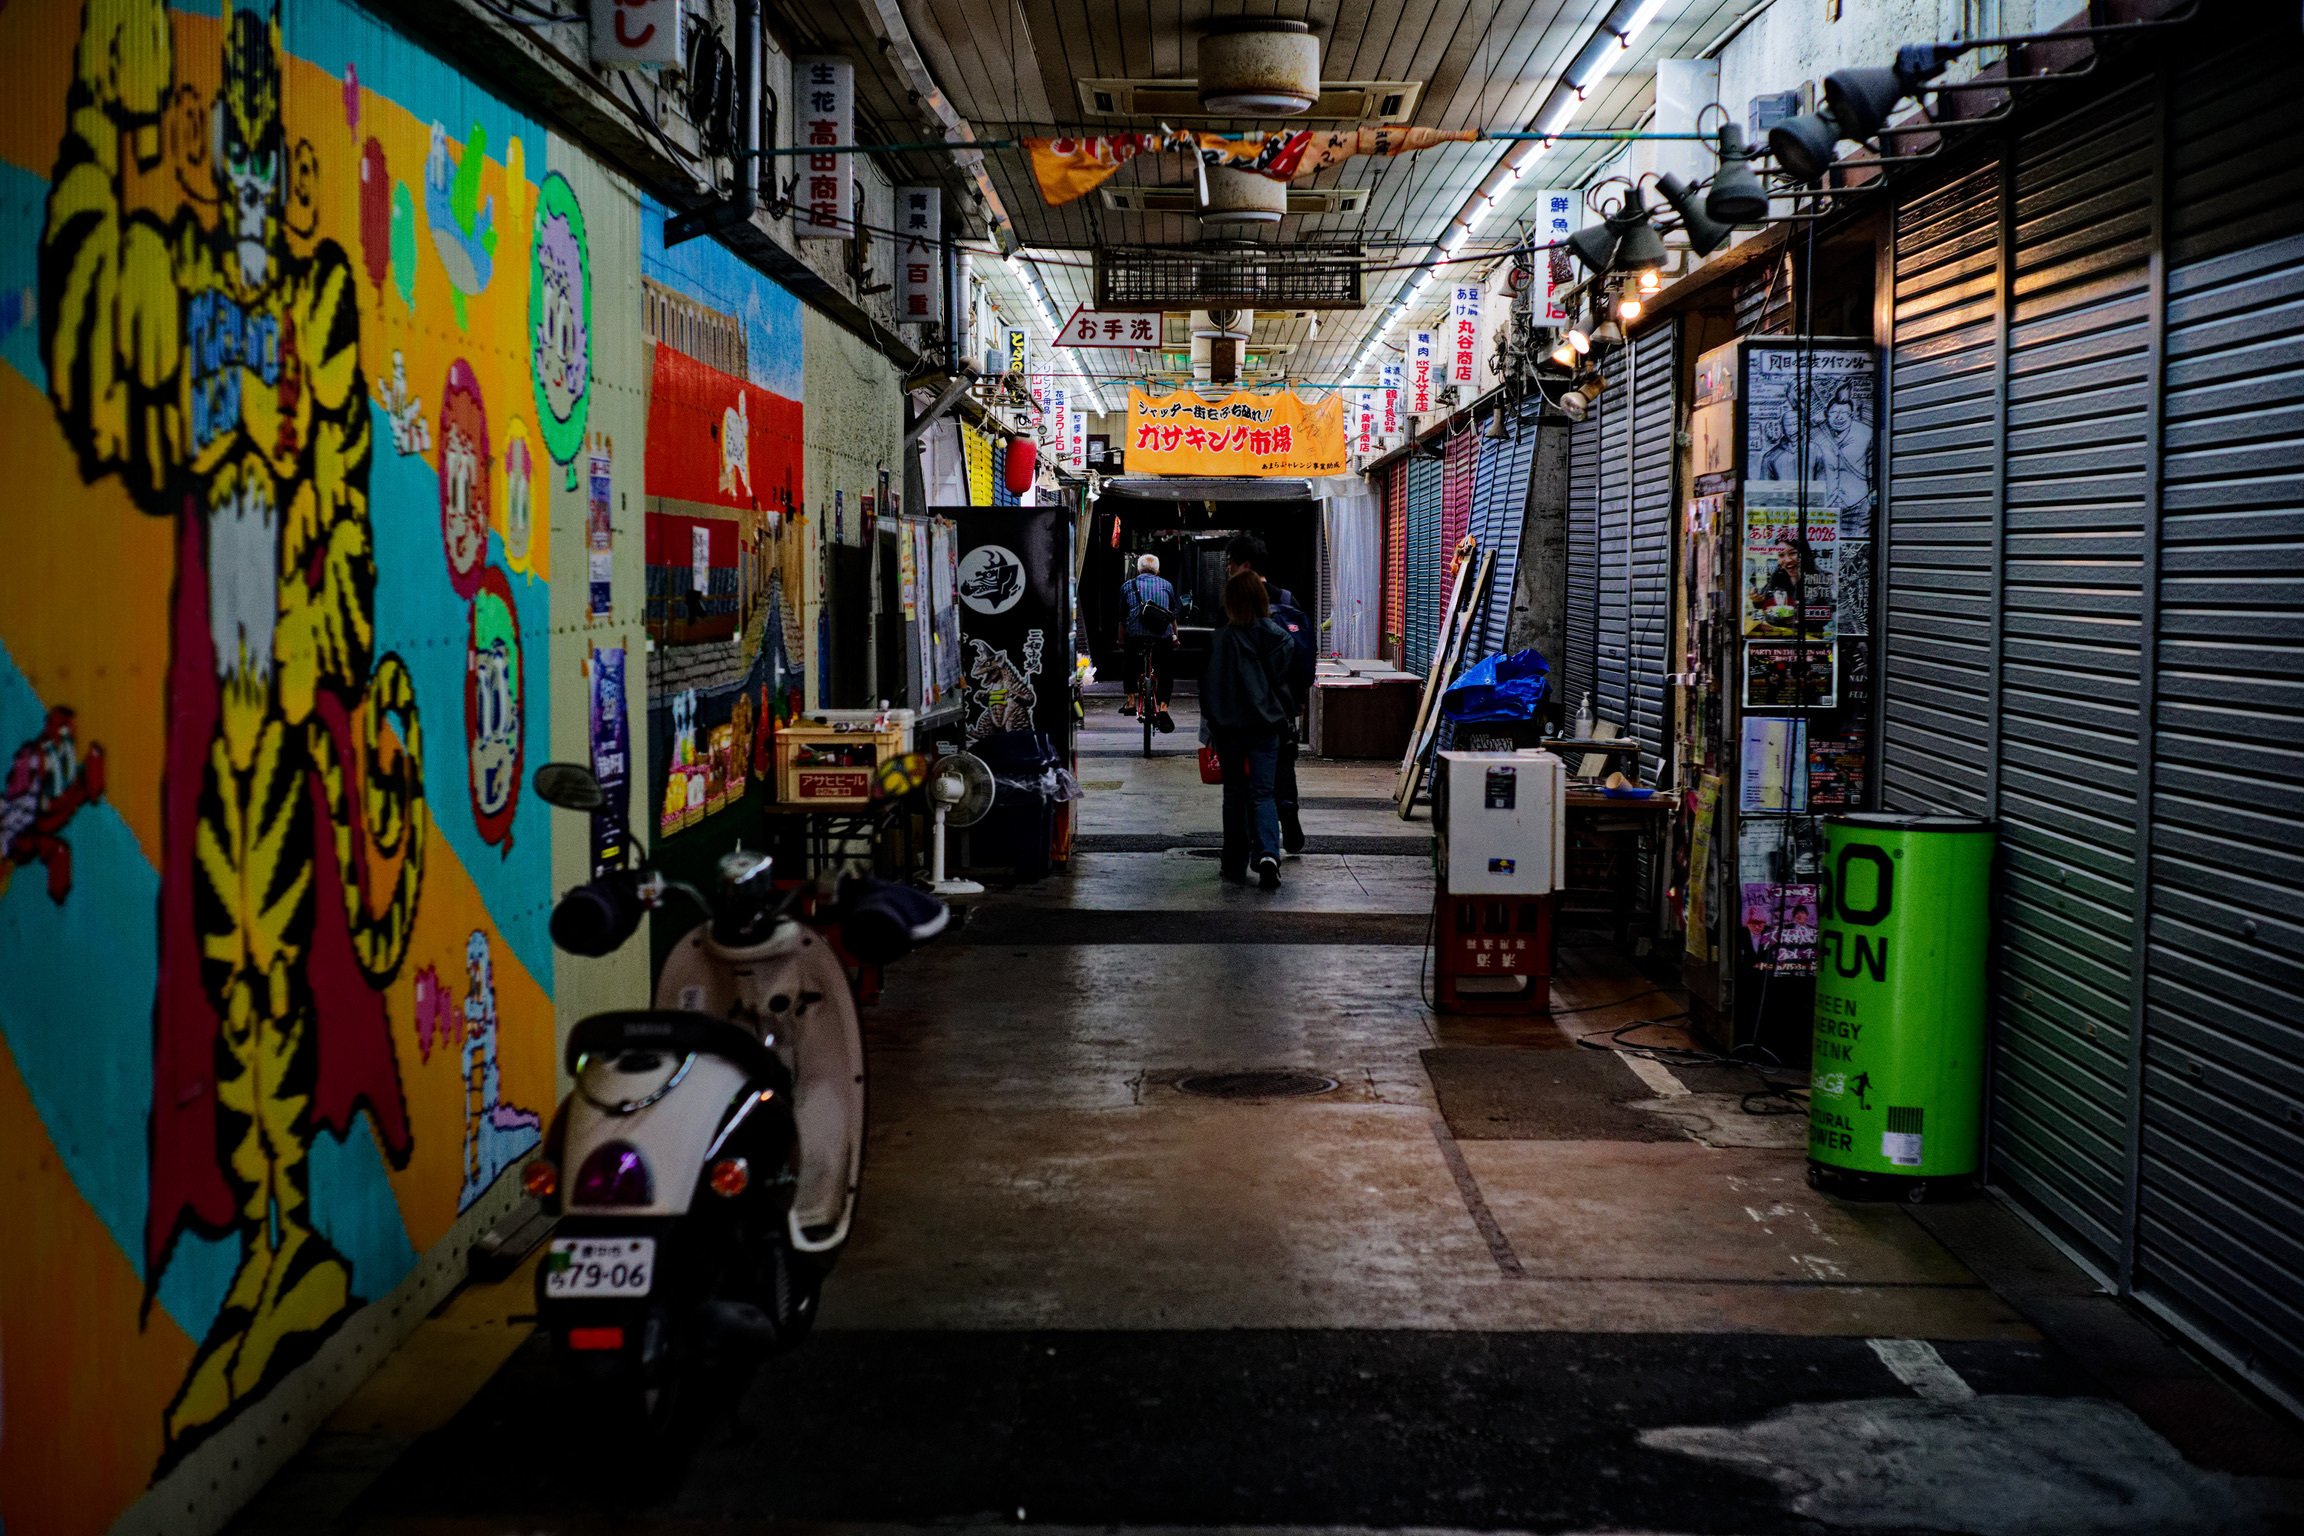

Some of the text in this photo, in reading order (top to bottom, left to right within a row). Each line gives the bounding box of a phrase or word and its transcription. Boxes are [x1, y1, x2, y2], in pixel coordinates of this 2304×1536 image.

[810, 63, 836, 113] 生花
[809, 119, 838, 228] 高田商店
[909, 193, 928, 229] 青果
[1550, 197, 1569, 234] 鮮魚
[906, 235, 930, 315] 八百重
[1077, 318, 1154, 341] お手洗
[1417, 333, 1430, 357] 精肉
[1455, 319, 1475, 381] 丸谷商店
[1073, 436, 1082, 466] 春日野
[1135, 423, 1294, 456] ガサキング市場
[1023, 629, 1044, 675] 三和市場
[1750, 648, 1772, 656] PARTY
[801, 775, 866, 786] アサヒビール
[1476, 953, 1516, 968] 清酒
[1820, 929, 1888, 982] FUN
[568, 1263, 645, 1288] 79-06
